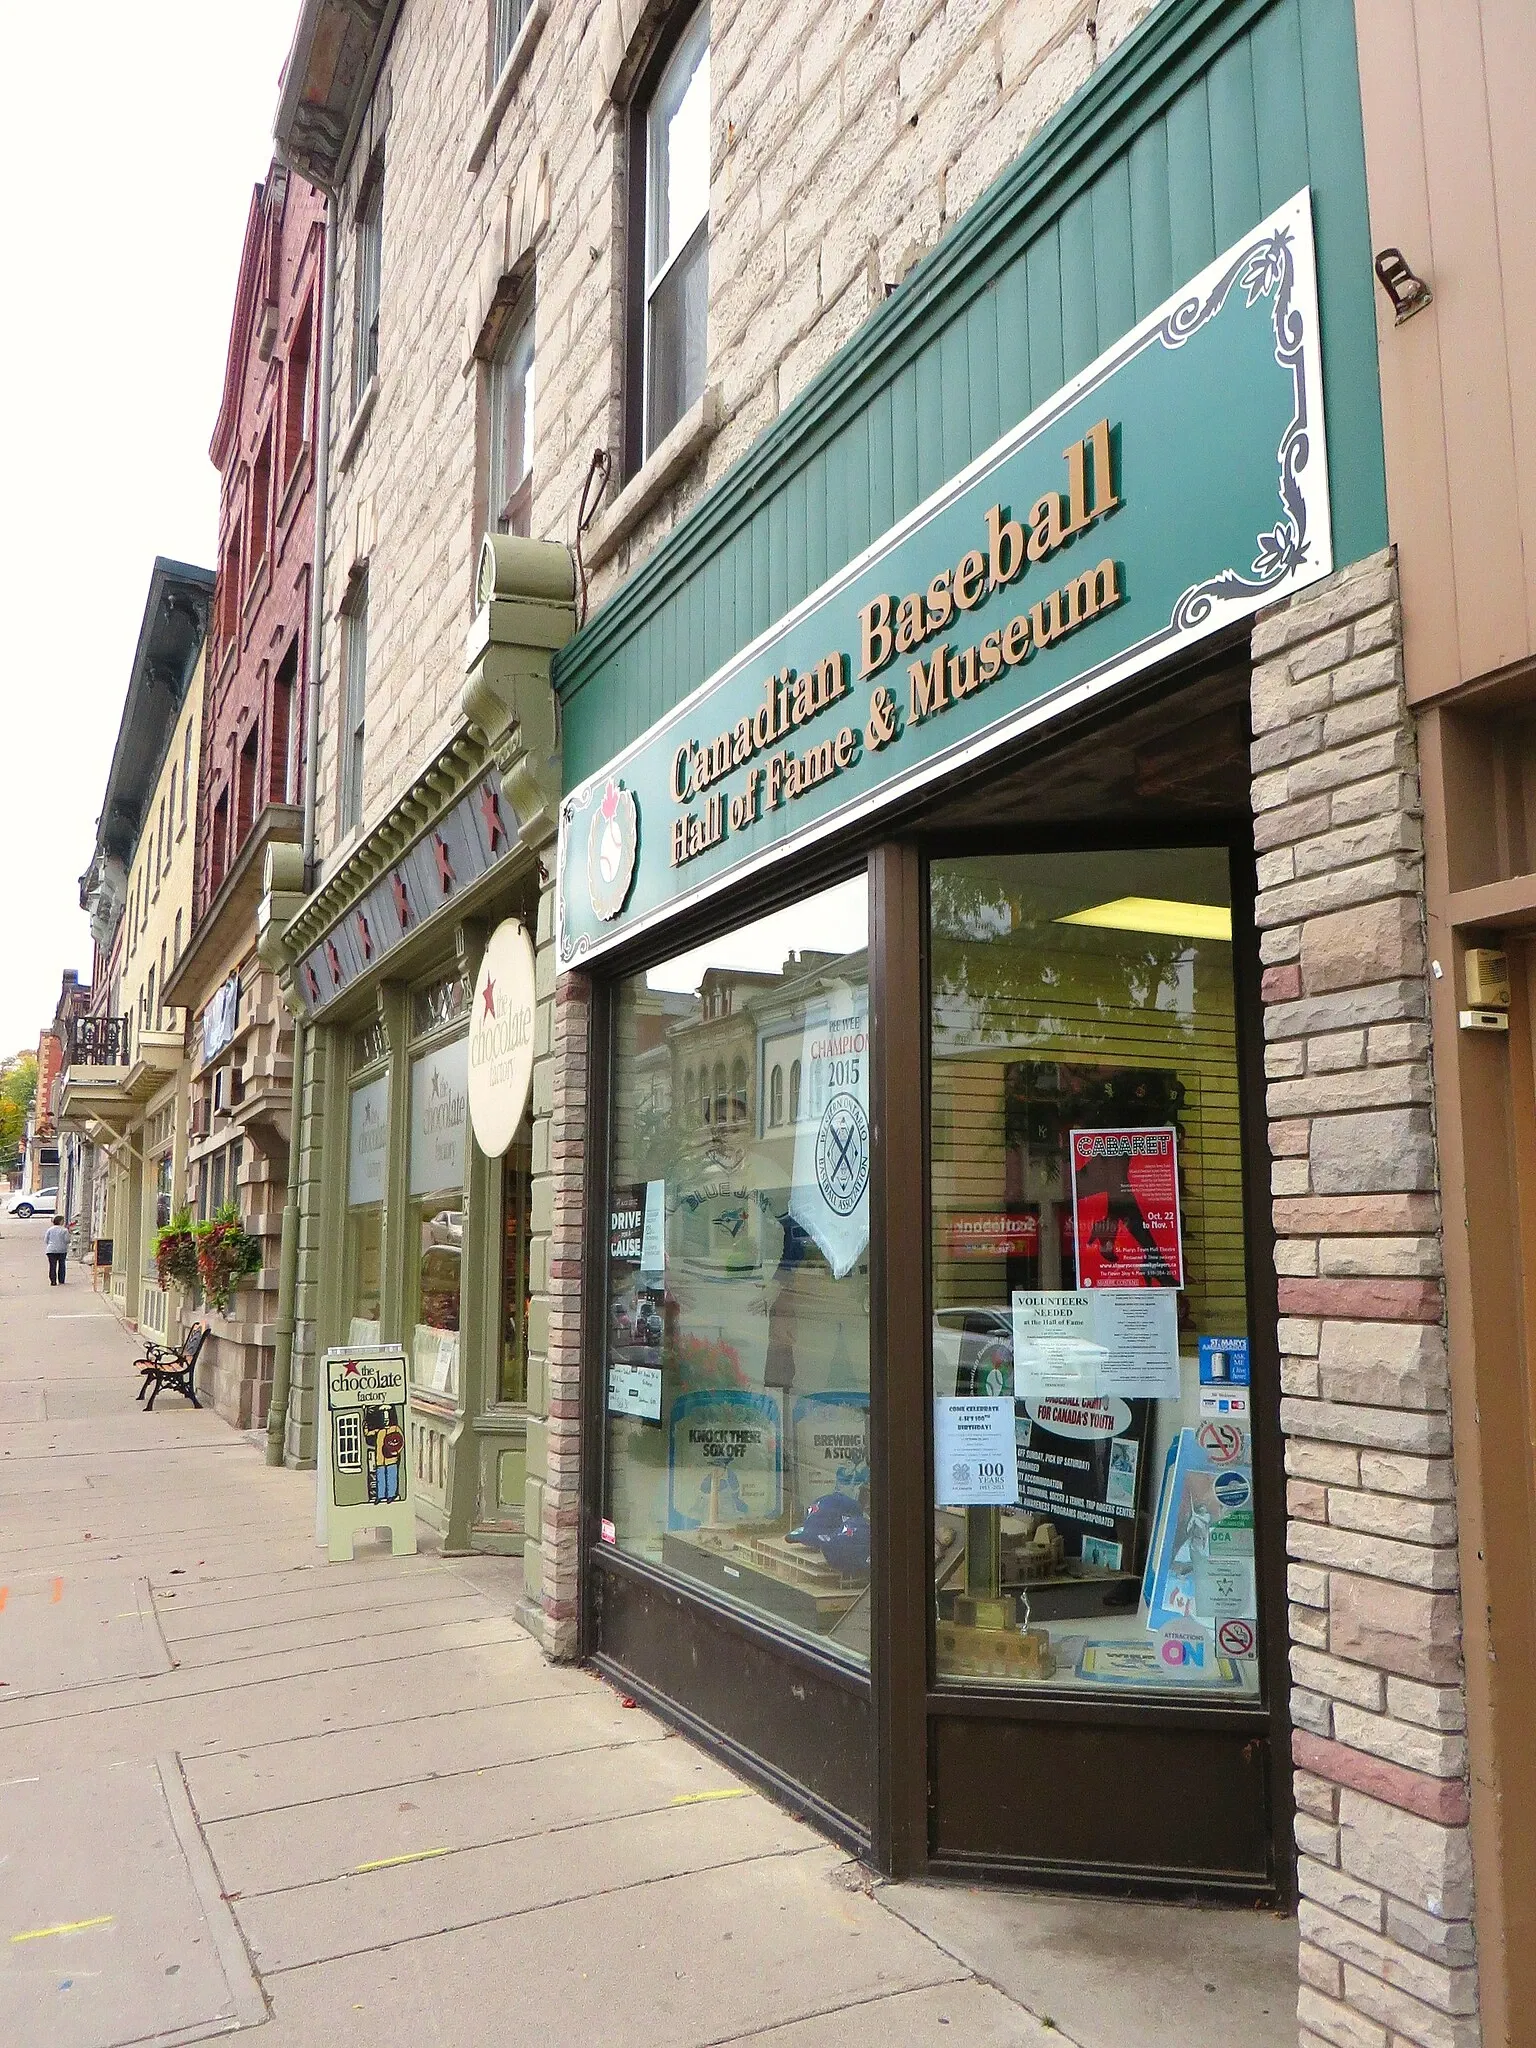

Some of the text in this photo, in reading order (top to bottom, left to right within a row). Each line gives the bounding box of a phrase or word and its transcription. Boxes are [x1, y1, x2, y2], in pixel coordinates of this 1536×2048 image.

[669, 419, 1119, 803] Canadian Baseball
[669, 557, 1119, 868] Hall of Fame & Museum
[842, 1016, 860, 1030] WEE
[471, 1000, 531, 1068] chocolate
[828, 1059, 860, 1087] 2015
[1077, 1135, 1171, 1157] CABARET
[685, 1182, 732, 1212] BLUE
[611, 1210, 642, 1230] DRIVE
[1147, 1211, 1174, 1220] Oct. 22
[1142, 1221, 1174, 1229] to Nov. 1
[611, 1238, 641, 1257] CAUSE
[1018, 1297, 1089, 1306] VOLUNTEERS
[1034, 1309, 1073, 1317] NEEDED
[361, 1364, 375, 1377] the
[331, 1370, 402, 1393] chocolate
[357, 1390, 387, 1404] factory
[1038, 1405, 1115, 1430] FOR CANADA'S YOUTH
[689, 1430, 729, 1443] KNOCK
[702, 1443, 747, 1457] SOX OFF
[1045, 1452, 1056, 1464] PICK
[978, 1462, 1004, 1476] 100
[978, 1476, 1005, 1484] YEARS
[1164, 1632, 1204, 1640] ATTRACTIONS
[1161, 1639, 1204, 1668] ON
